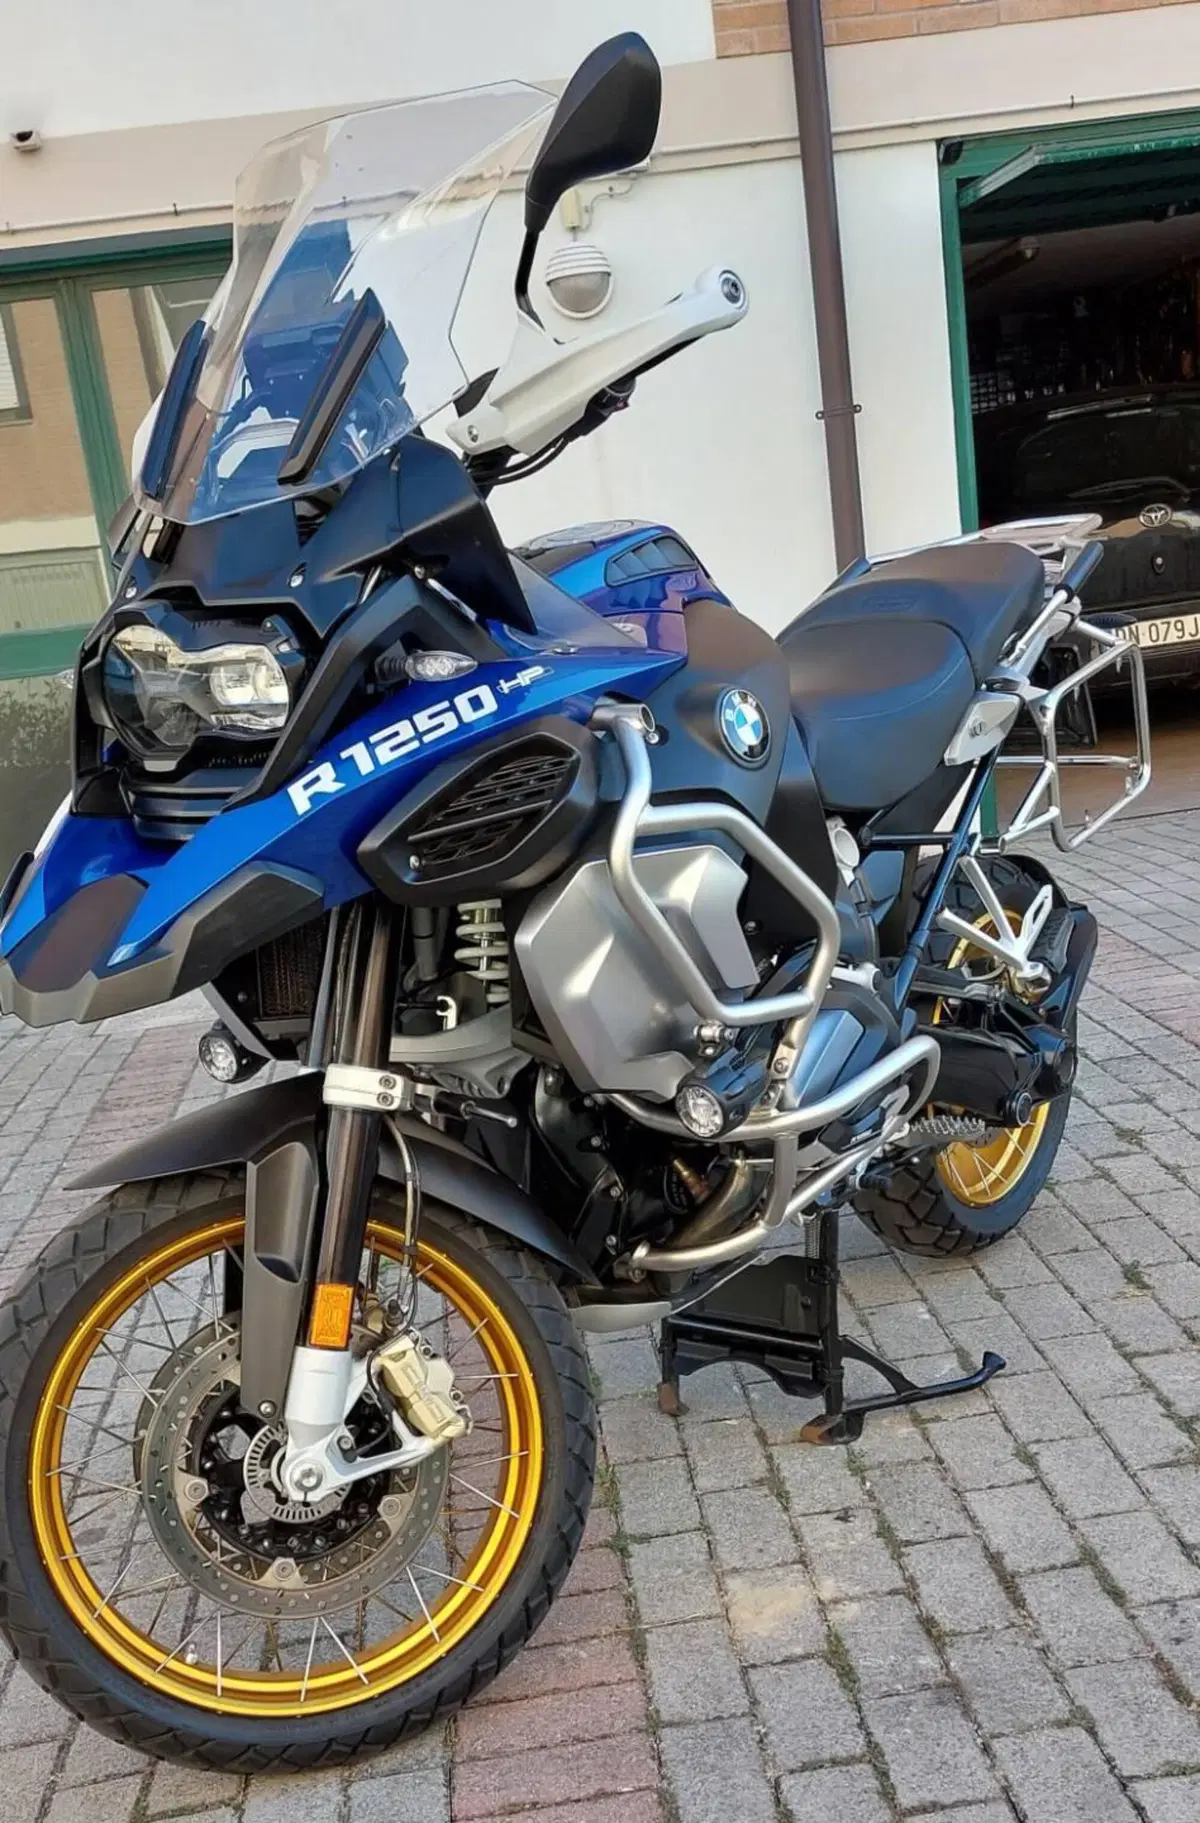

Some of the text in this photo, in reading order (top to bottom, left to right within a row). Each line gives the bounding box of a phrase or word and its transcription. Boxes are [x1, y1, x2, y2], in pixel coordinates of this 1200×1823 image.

[286, 665, 550, 816] R 1250 HP
[724, 691, 758, 722] BMW
